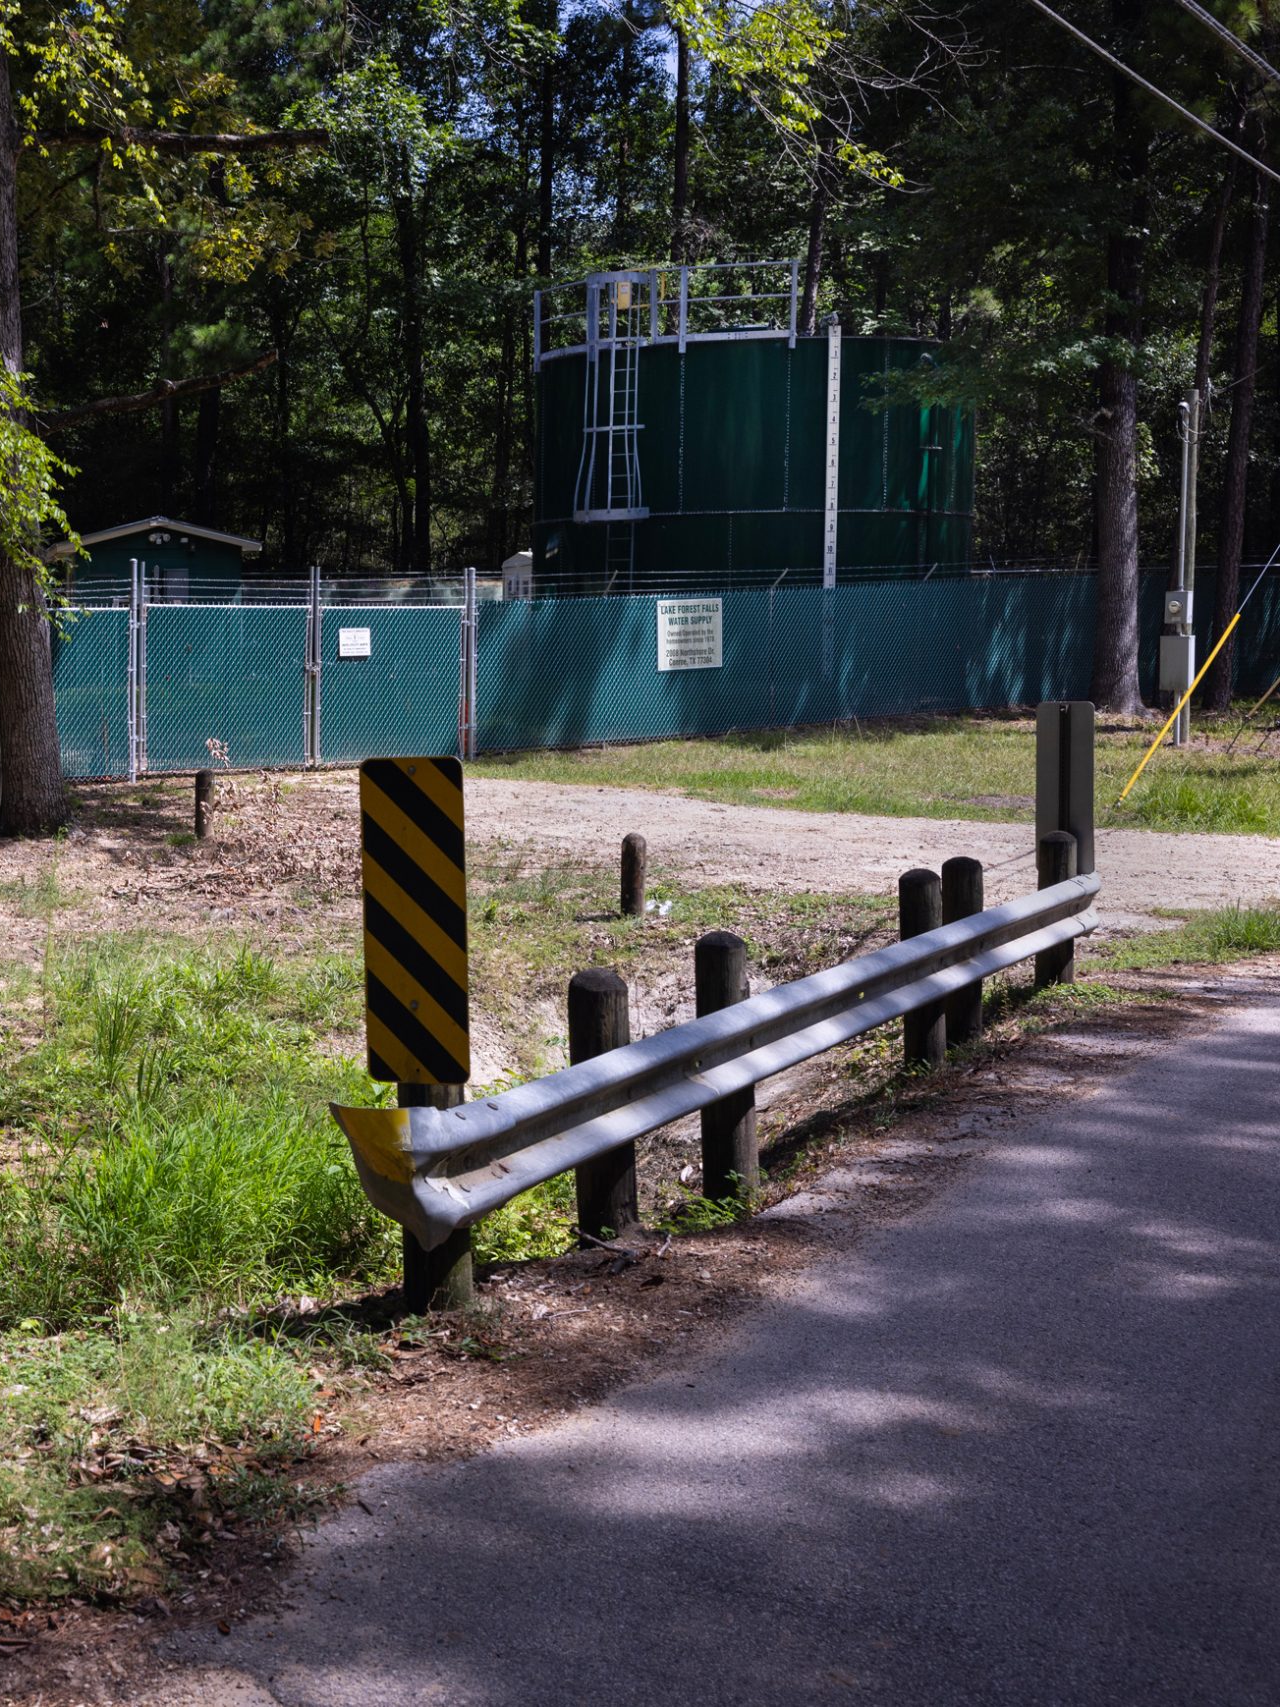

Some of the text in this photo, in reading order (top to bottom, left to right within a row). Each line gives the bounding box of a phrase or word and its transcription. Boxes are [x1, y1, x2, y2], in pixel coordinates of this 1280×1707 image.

[660, 603, 719, 615] LAKE FOREST FALLS
[668, 615, 713, 626] WATER SUPPLY
[689, 656, 696, 664] TX
